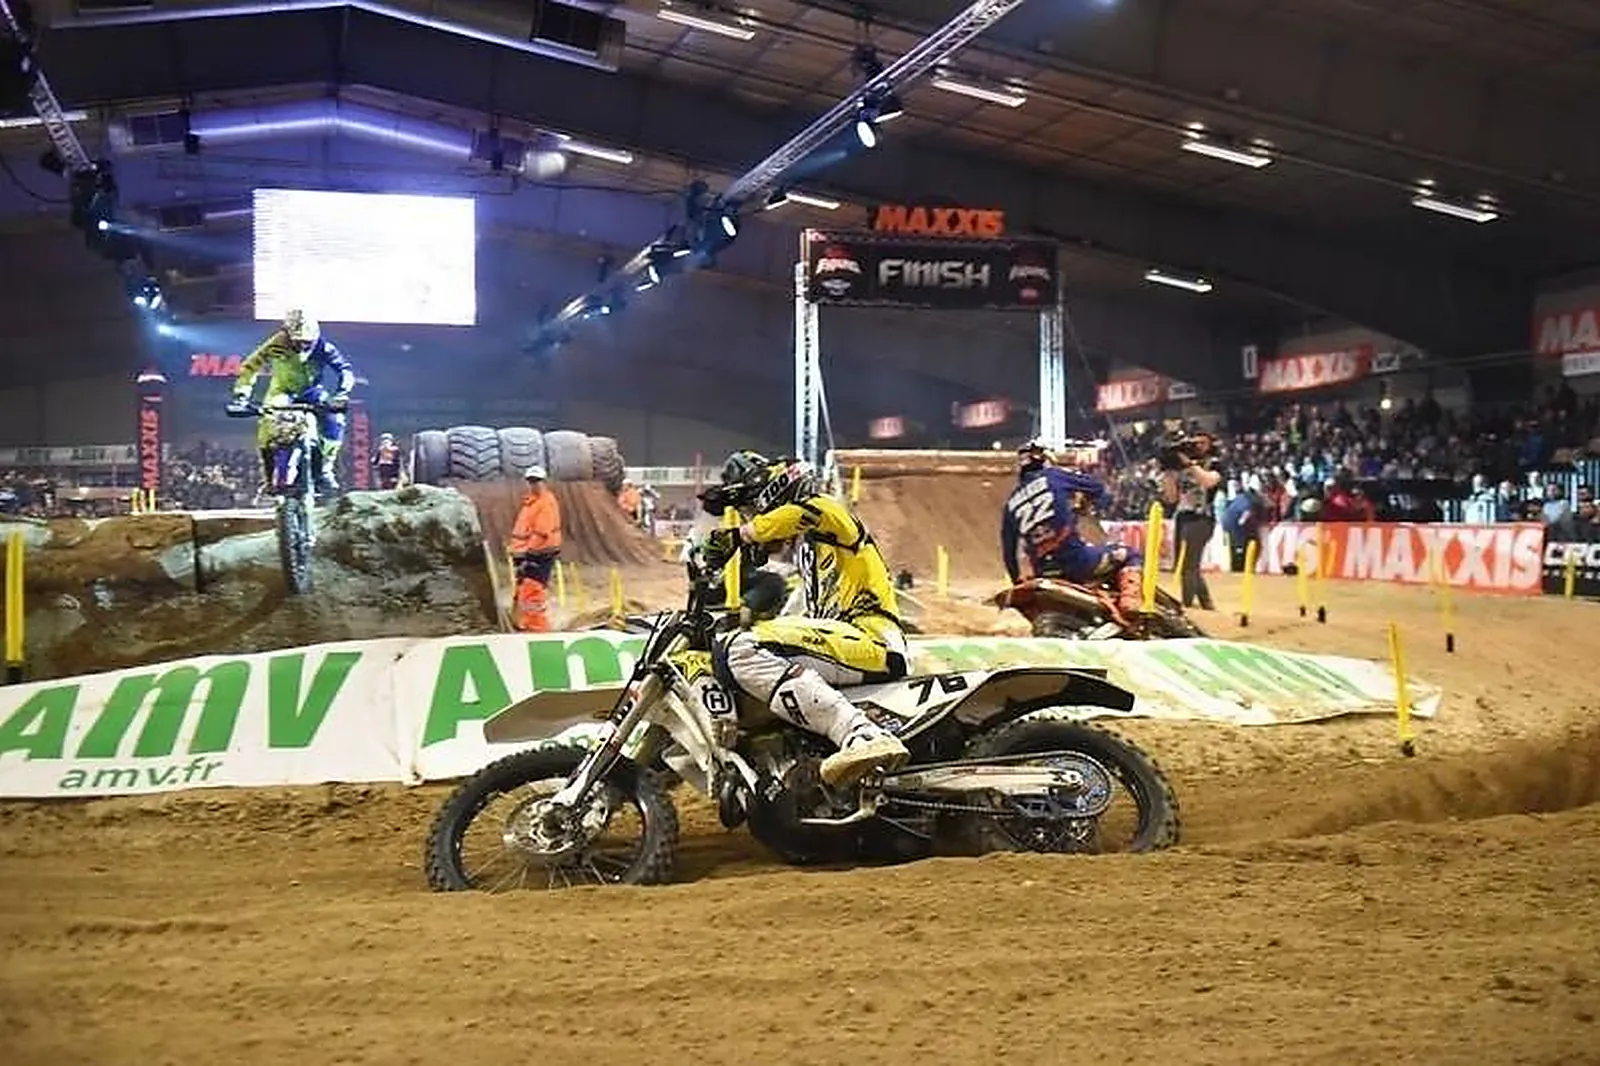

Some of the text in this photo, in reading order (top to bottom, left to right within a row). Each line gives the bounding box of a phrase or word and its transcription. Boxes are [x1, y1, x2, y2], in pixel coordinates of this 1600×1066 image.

[875, 206, 1004, 236] MAXXIS
[879, 258, 990, 289] FINISH
[190, 353, 244, 376] MA
[1260, 351, 1356, 391] MAXXIS
[139, 409, 161, 488] MAXXIS
[1015, 491, 1056, 533] 22
[1255, 522, 1318, 576] XIS
[1342, 526, 1544, 590] MAXXIS
[908, 674, 968, 707] 76
[58, 757, 224, 790] amv.fr
